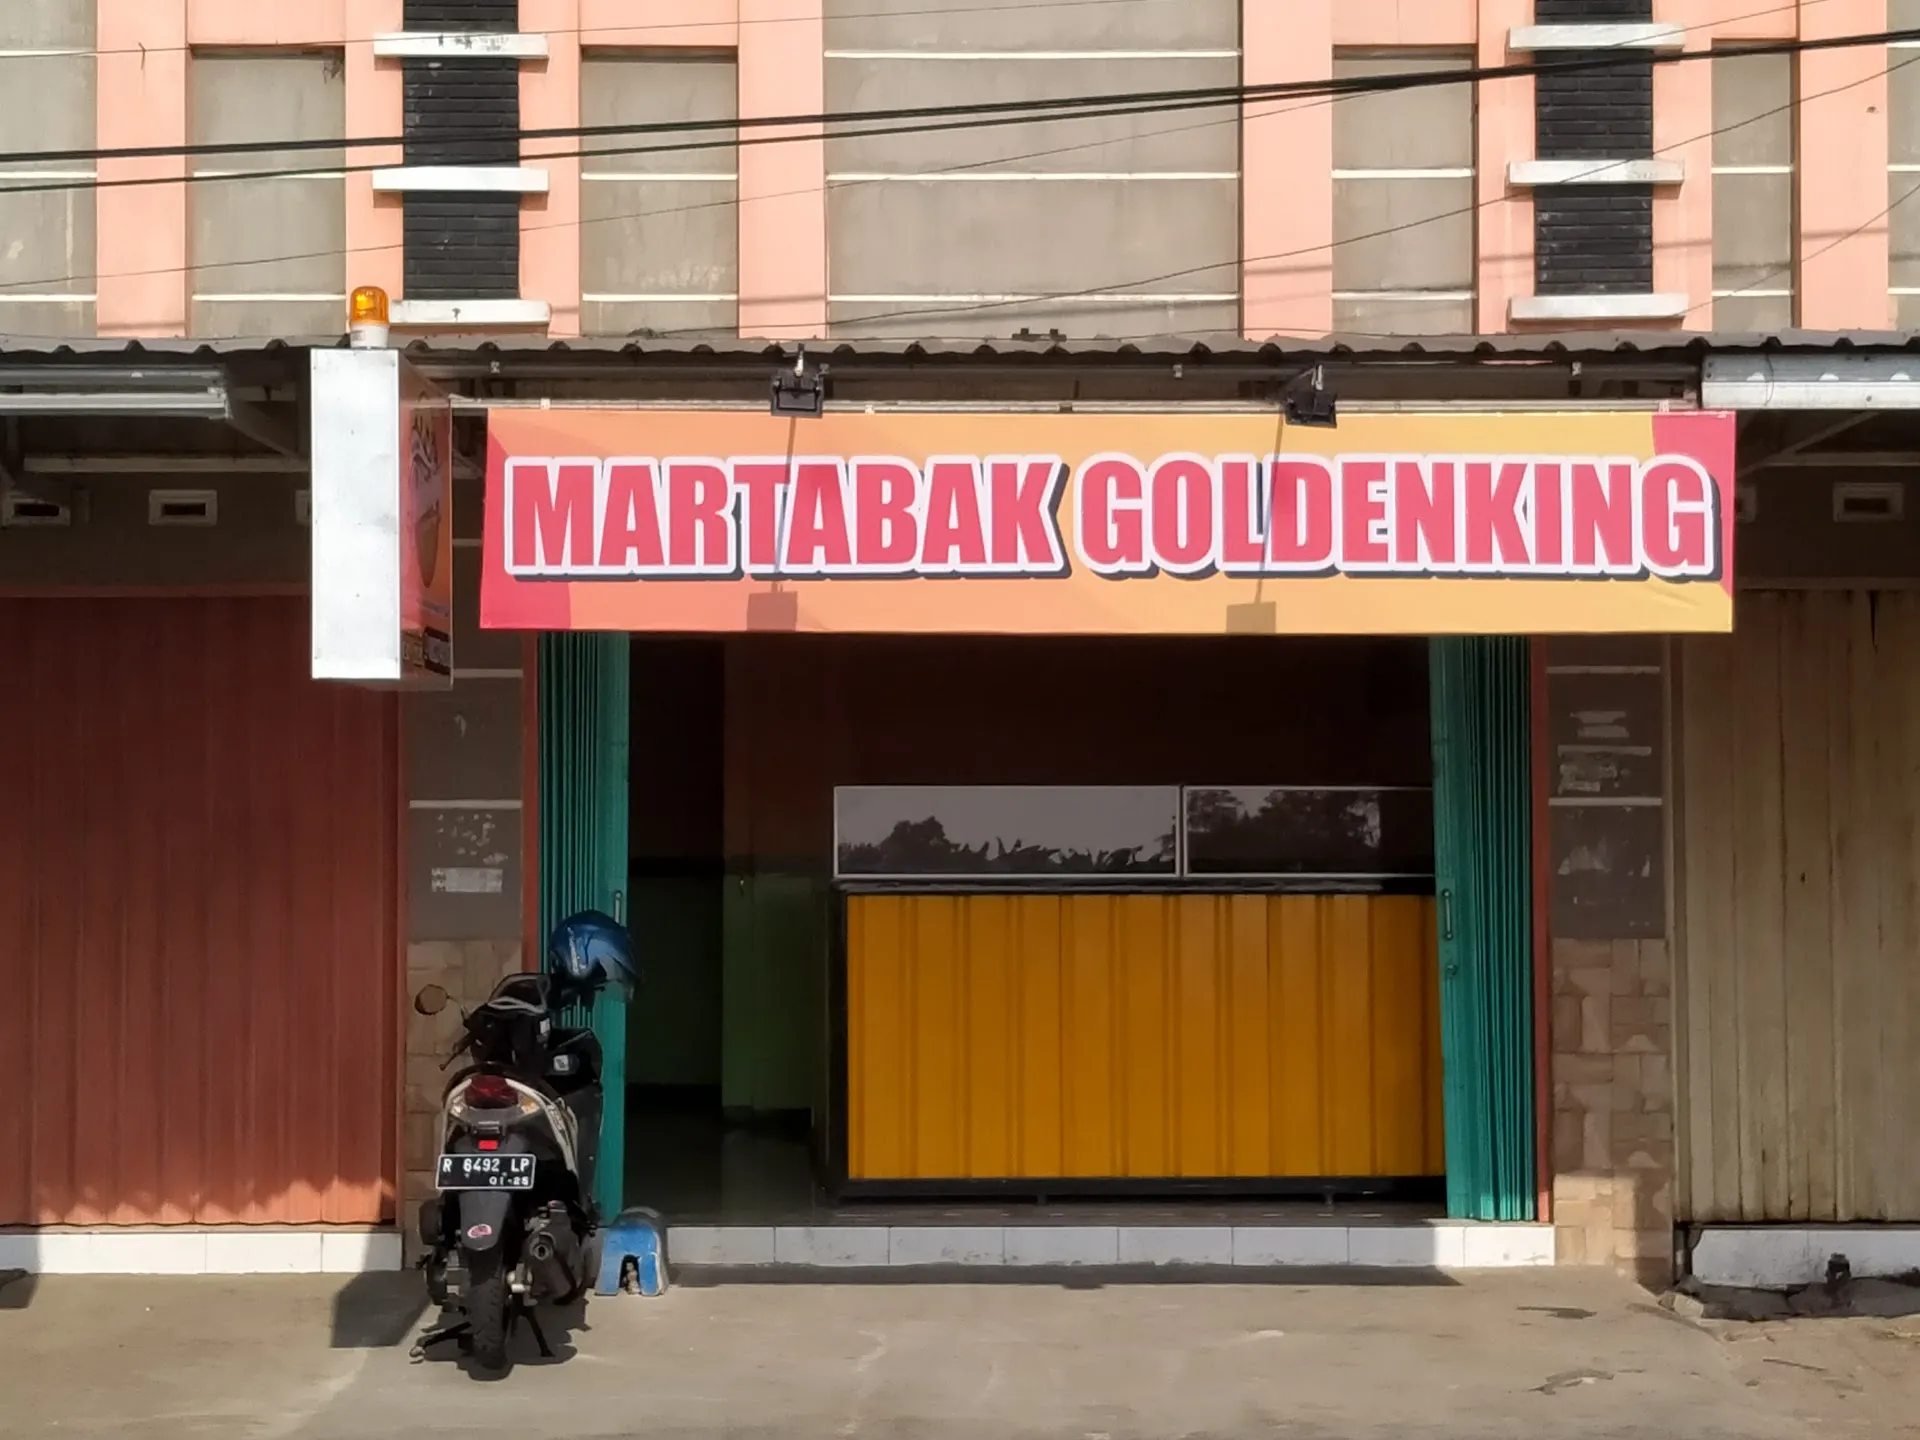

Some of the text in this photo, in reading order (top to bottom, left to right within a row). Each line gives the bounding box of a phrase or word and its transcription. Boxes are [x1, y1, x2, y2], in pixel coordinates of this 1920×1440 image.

[506, 452, 1718, 577] MARTABAK GOLDENKING
[442, 1158, 530, 1173] R 6492 LP
